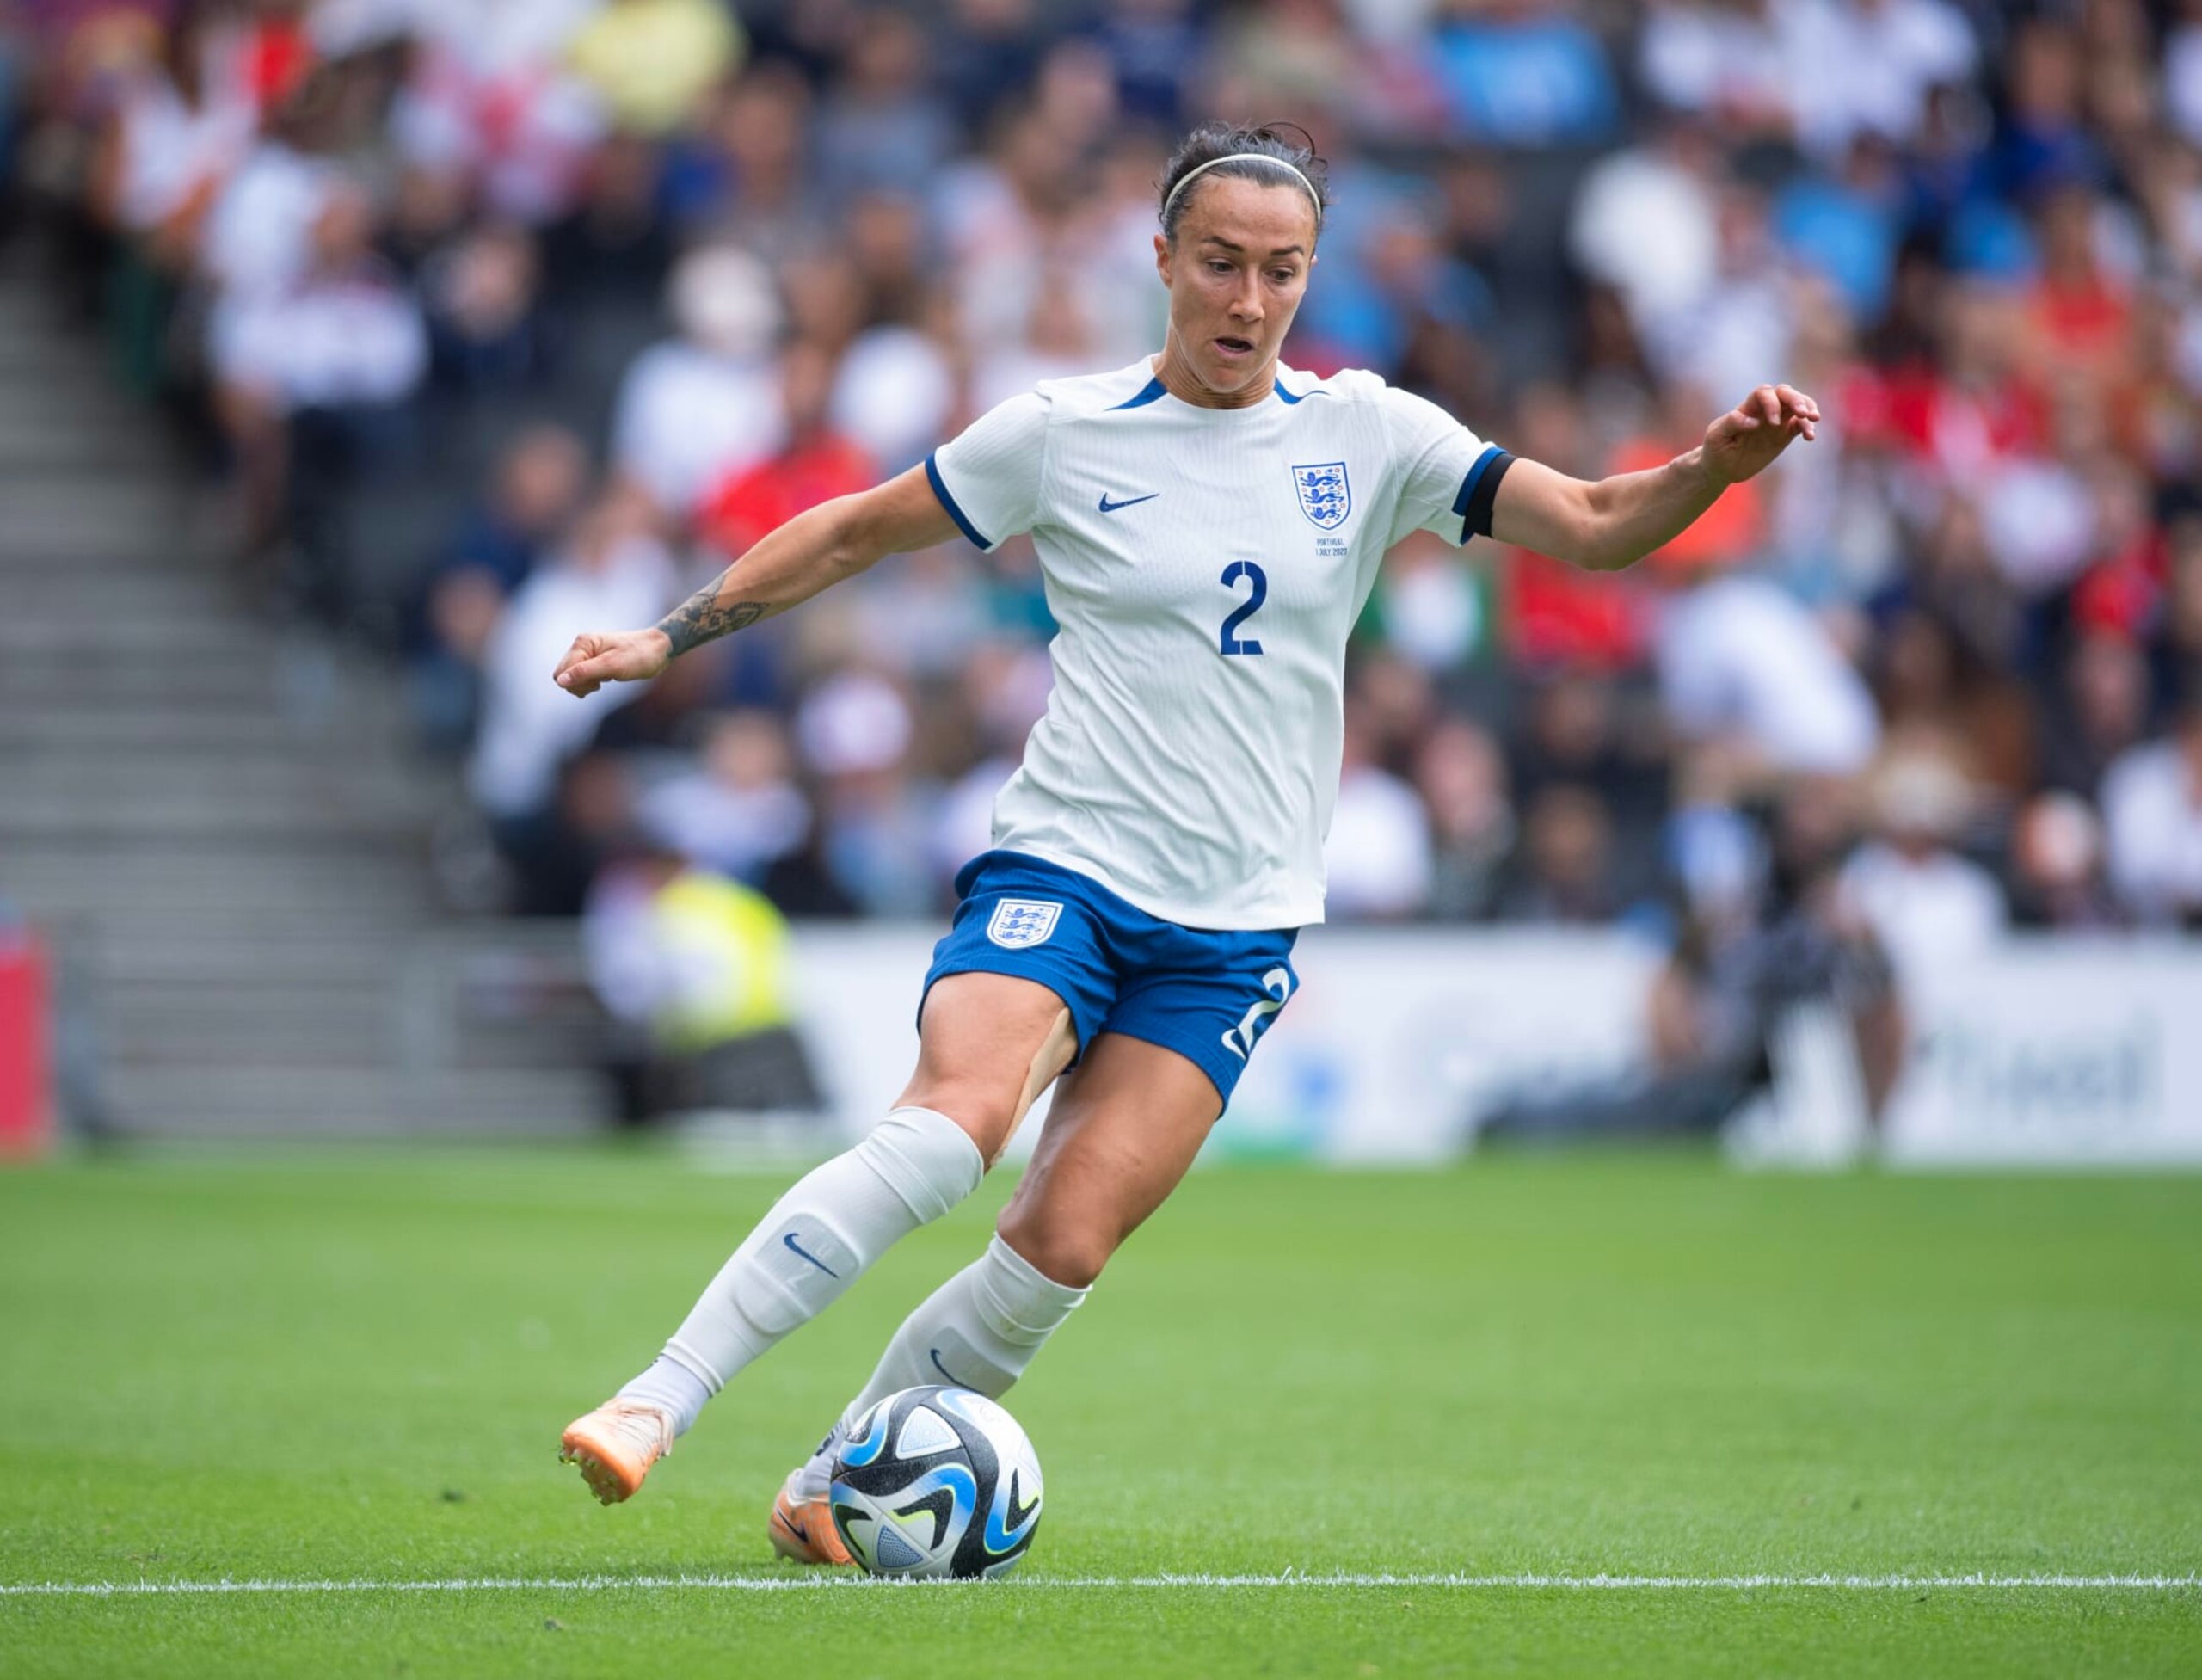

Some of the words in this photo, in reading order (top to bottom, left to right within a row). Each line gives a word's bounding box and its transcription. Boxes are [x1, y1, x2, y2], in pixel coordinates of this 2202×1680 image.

[1316, 538, 1344, 546] PORTUGAL
[1319, 547, 1332, 556] JULY
[1332, 547, 1348, 556] 2023
[1220, 560, 1268, 655] 2
[1221, 967, 1290, 1060] 2
